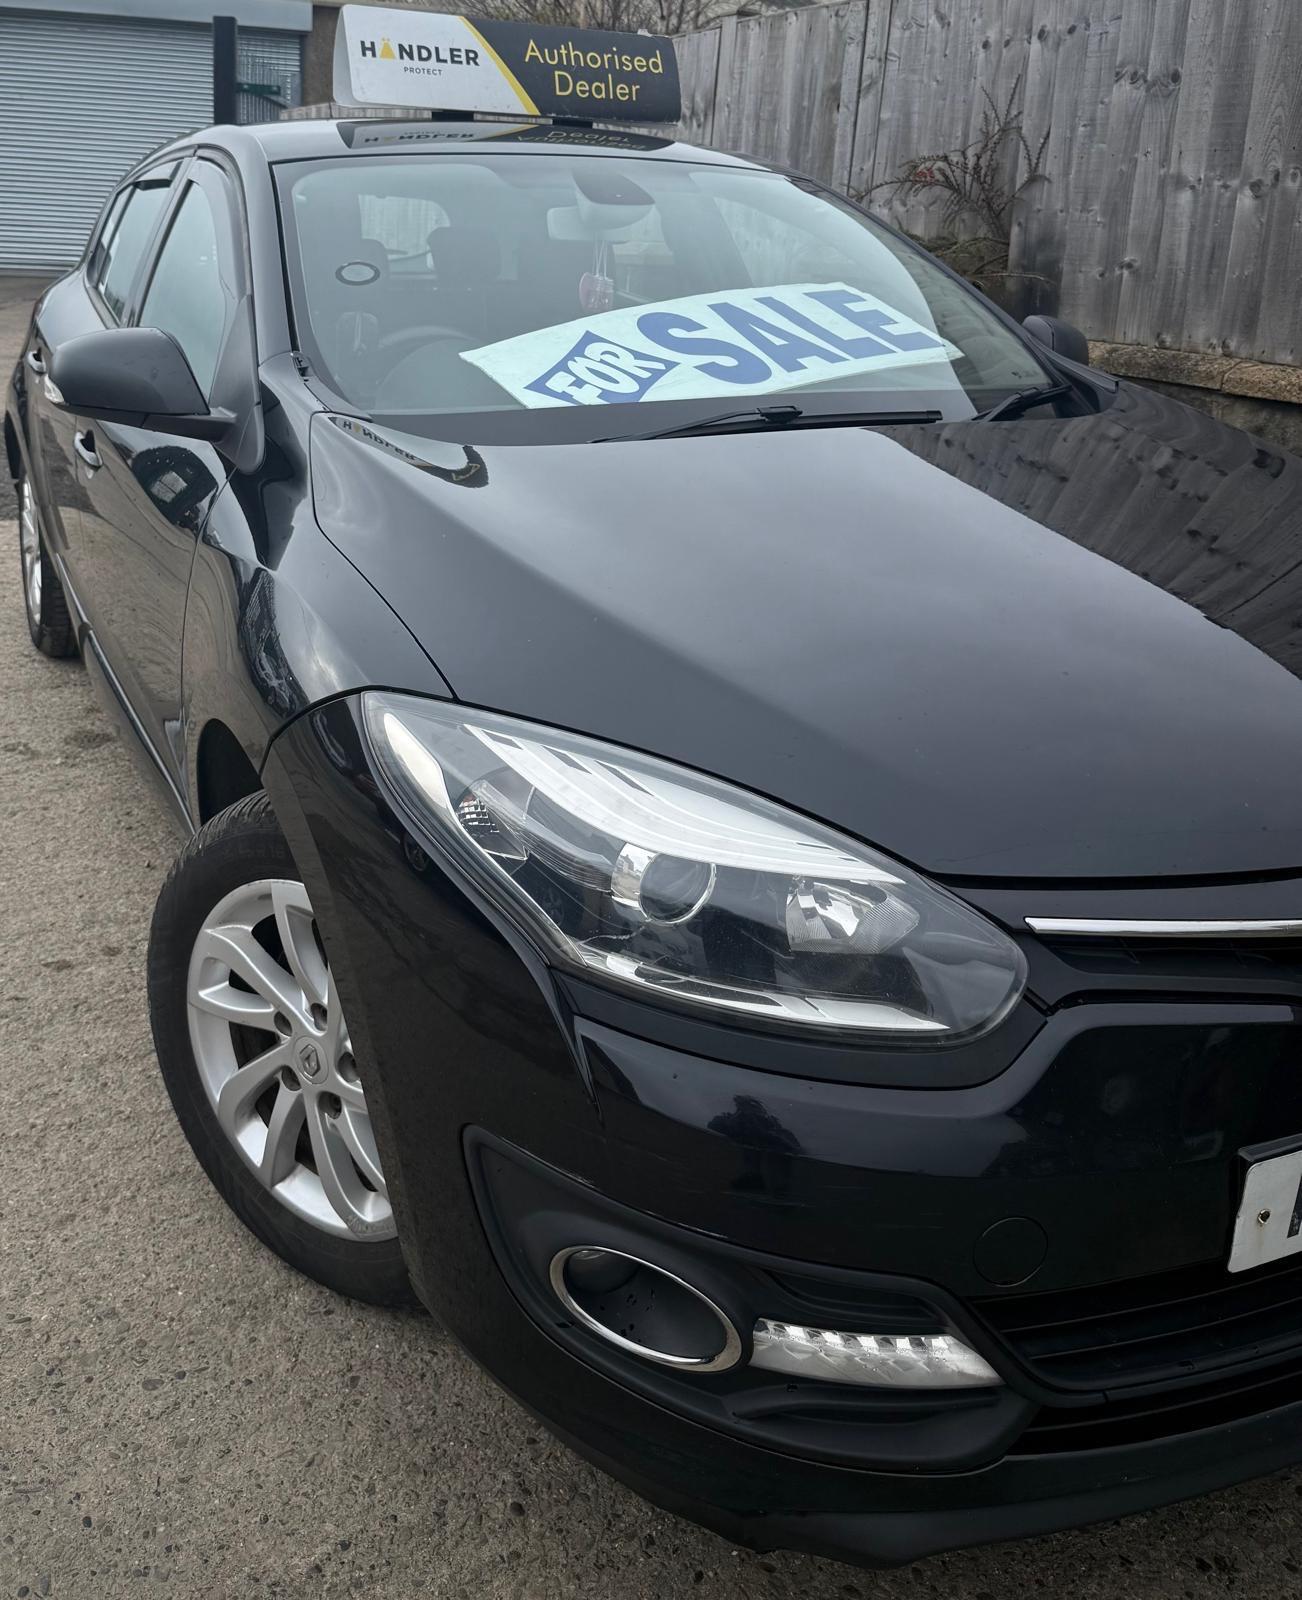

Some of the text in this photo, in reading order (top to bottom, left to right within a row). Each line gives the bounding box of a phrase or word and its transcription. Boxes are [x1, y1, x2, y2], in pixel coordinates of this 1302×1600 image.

[403, 66, 443, 76] PROTECT
[525, 39, 663, 74] Authorised
[554, 70, 640, 101] Dealer
[544, 289, 946, 405] FOR SALE
